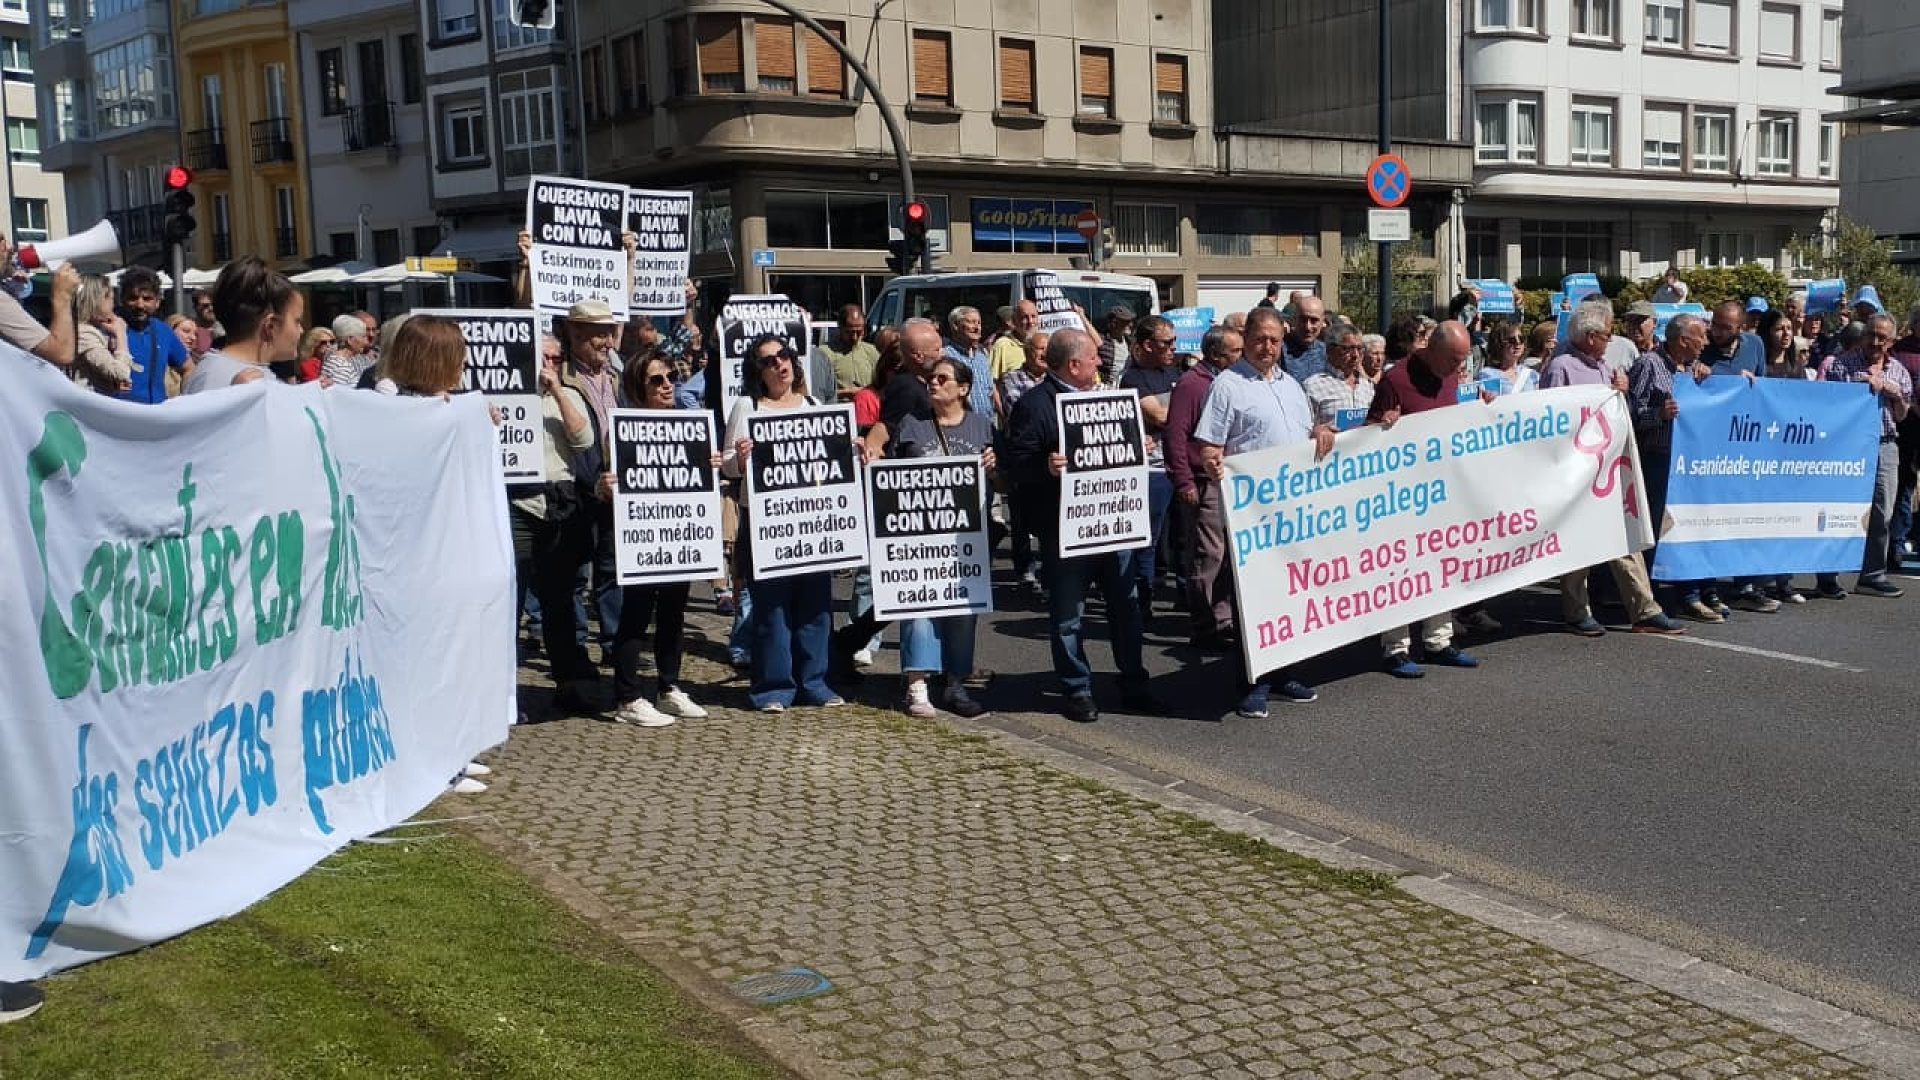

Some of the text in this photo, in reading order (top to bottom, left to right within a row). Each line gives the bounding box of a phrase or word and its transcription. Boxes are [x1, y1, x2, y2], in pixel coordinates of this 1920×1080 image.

[537, 185, 620, 211] QUEREMOS
[554, 206, 602, 227] NAVIA
[641, 216, 679, 231] NAVIA
[542, 224, 613, 247] CON VIDA
[662, 233, 685, 248] VIDA
[541, 251, 614, 272] Esiximos o
[635, 258, 677, 271] siximos
[537, 271, 620, 290] noso médico
[633, 291, 663, 304] cada
[722, 302, 800, 320] QUEREMOS
[743, 320, 788, 337] NAVIA
[464, 345, 508, 366] AVIA
[476, 368, 524, 390] VIDA
[515, 406, 526, 421] o
[1065, 400, 1134, 424] QUEREMOS
[618, 421, 706, 442] QUEREMOS
[753, 415, 847, 443] QUEREMOS
[1082, 422, 1125, 445] NAVIA
[1728, 414, 1761, 442] Nin
[1766, 419, 1780, 440] +
[1783, 416, 1815, 444] nin
[635, 443, 688, 466] NAVIA
[773, 438, 828, 464] NAVIA
[1074, 443, 1136, 468] CON VIDA
[1231, 405, 1570, 511] Defendamos a sanidade
[626, 467, 703, 489] CON VIDA
[763, 459, 843, 487] CON VIDA
[876, 466, 975, 490] QUEREMOS
[1675, 455, 1866, 480] A sanidade que merecemos!
[1073, 476, 1137, 498] Esiximos o
[628, 501, 706, 520] Esiximos o
[764, 494, 847, 517] Esiximos o
[898, 489, 955, 511] NAVIA
[1067, 495, 1142, 519] noso médico
[759, 515, 857, 541] noso médico
[885, 509, 970, 532] CON VIDA
[1078, 519, 1109, 539] cada
[1235, 478, 1447, 566] pública galega
[623, 521, 714, 544] noso médico
[637, 545, 673, 567] cada
[775, 539, 814, 560] cada
[886, 542, 973, 561] Esiximos o
[1286, 506, 1539, 597] Non aos recortes
[250, 509, 304, 646] en
[880, 561, 982, 583] noso médico
[897, 584, 937, 604] cada
[1257, 530, 1562, 649] na Atención Primaria
[134, 689, 277, 870] servizos
